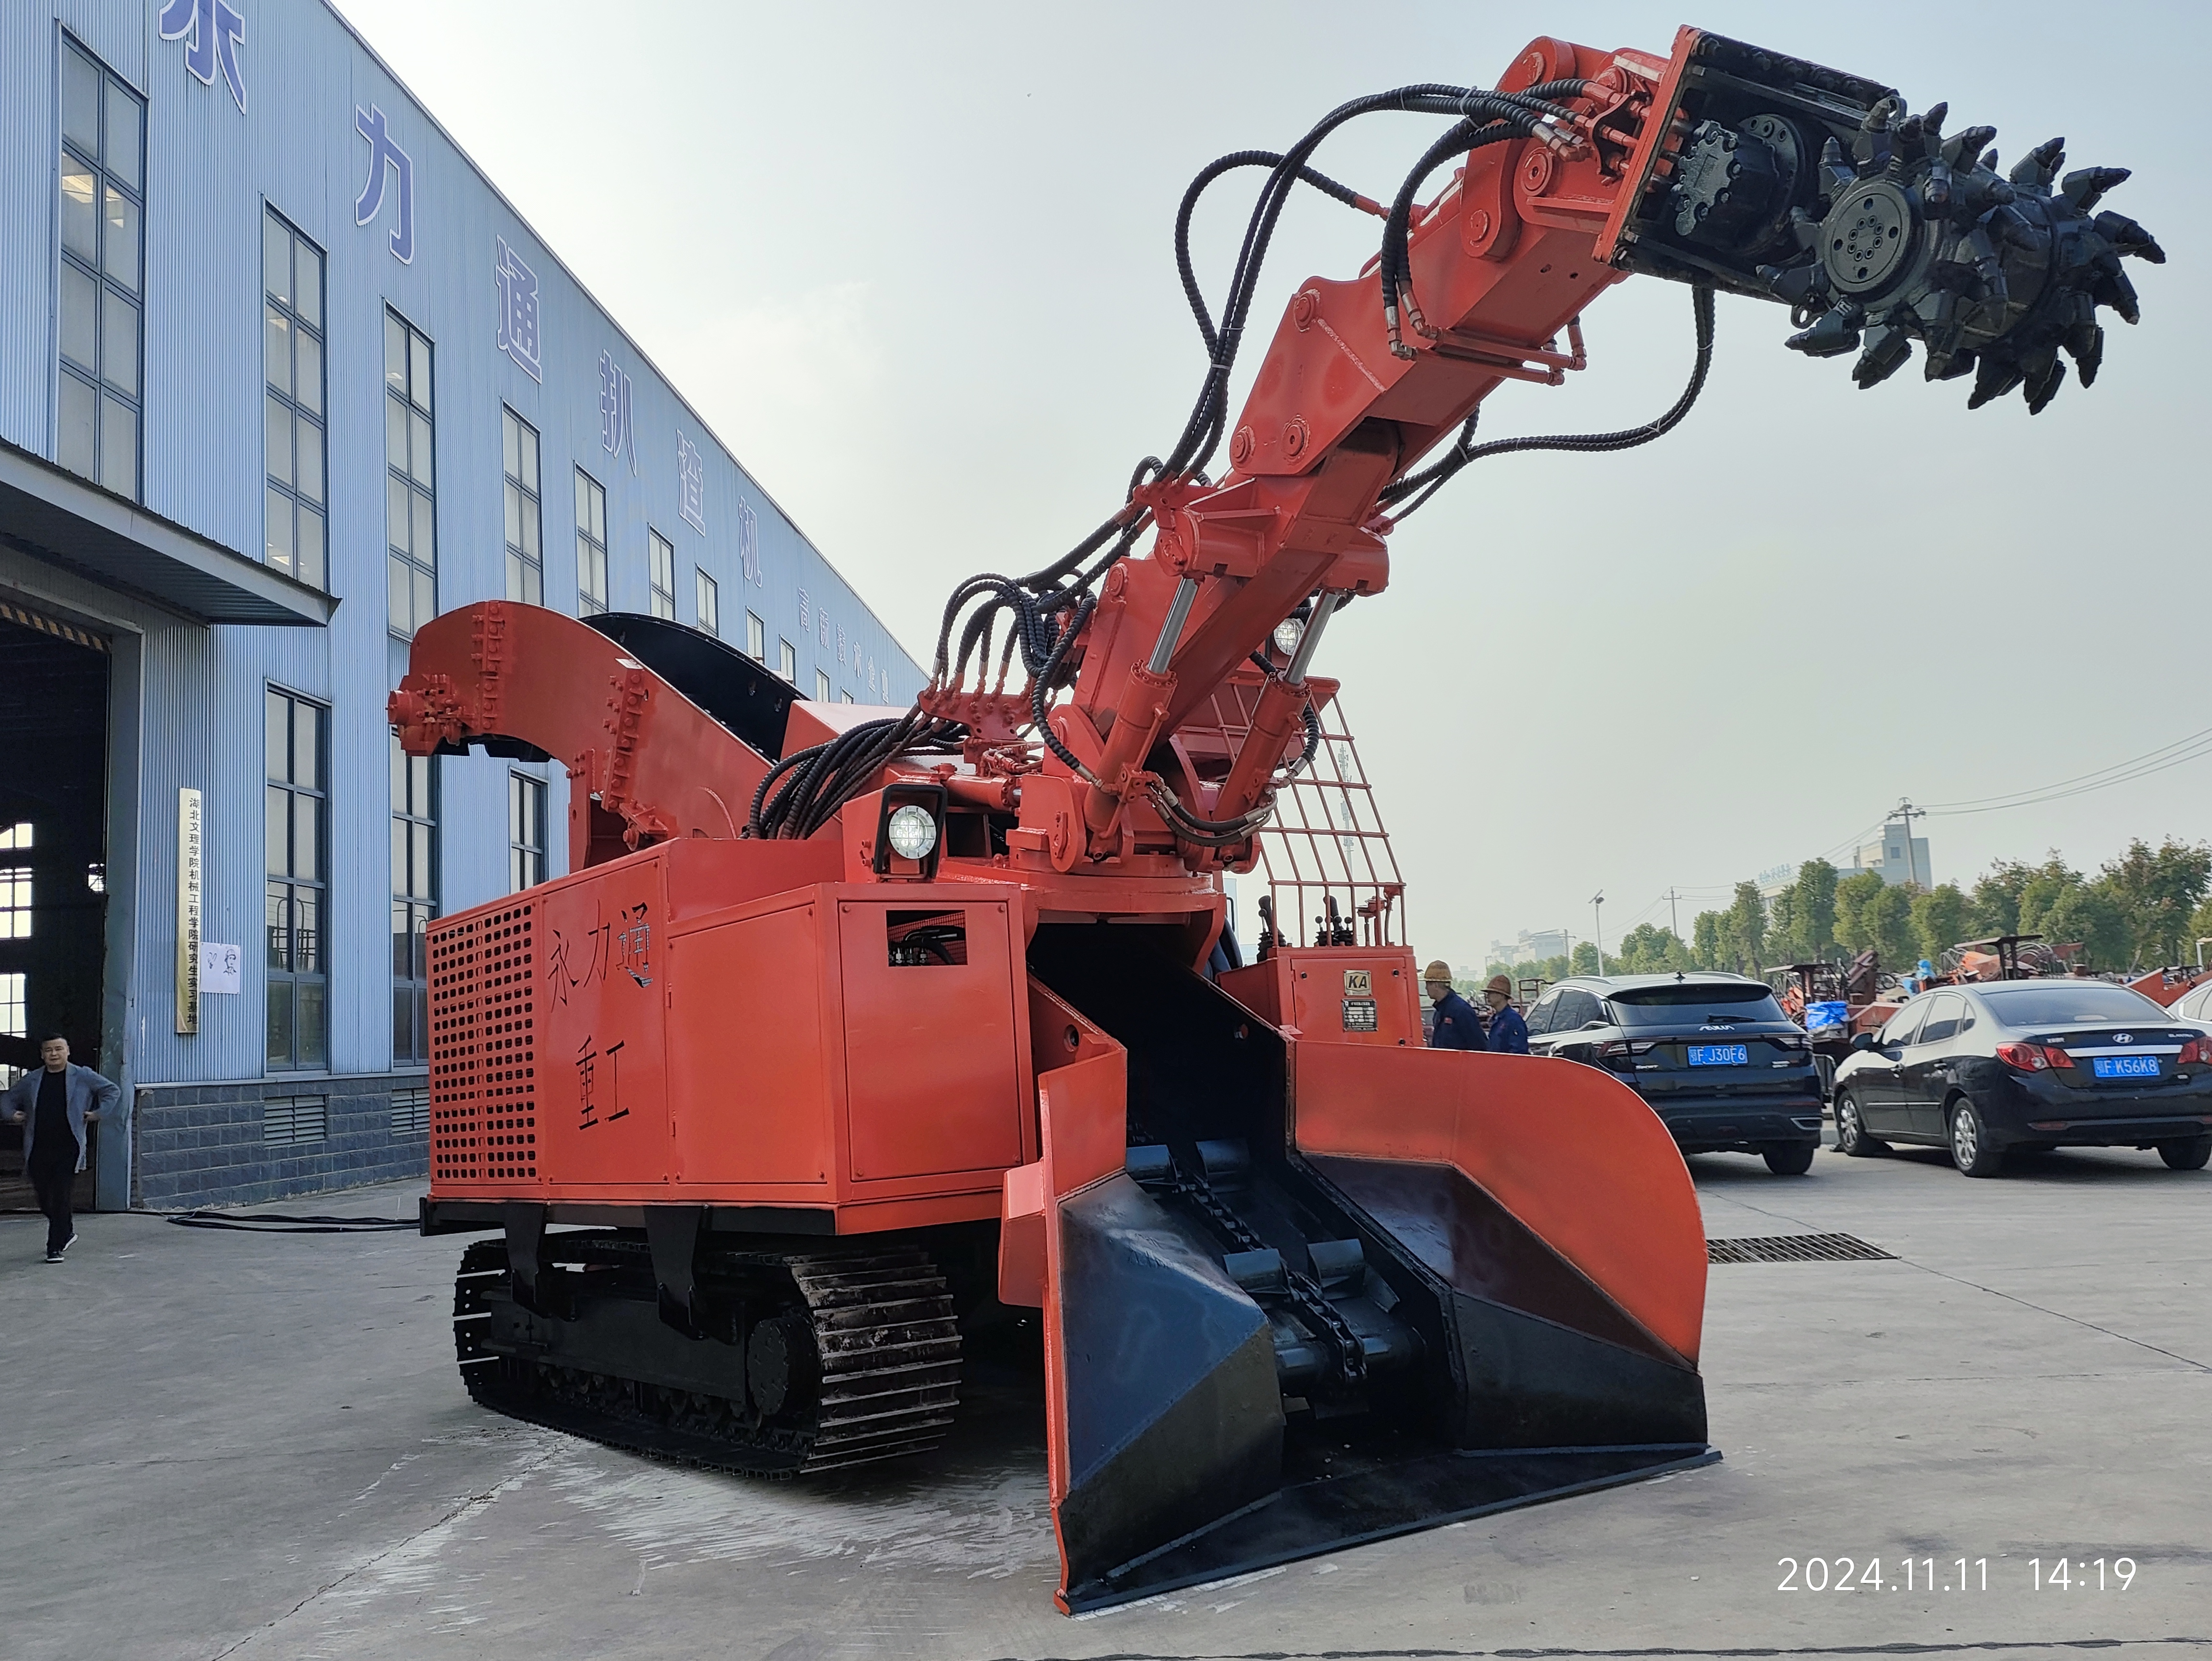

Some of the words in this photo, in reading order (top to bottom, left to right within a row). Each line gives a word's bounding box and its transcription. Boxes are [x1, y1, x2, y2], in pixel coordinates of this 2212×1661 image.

[798, 587, 889, 704] 高新技术企业
[187, 798, 200, 1024] 湖北文理学院机械工程学院研究生实习基地
[1348, 975, 1368, 988] KA
[575, 1034, 630, 1130] 重工
